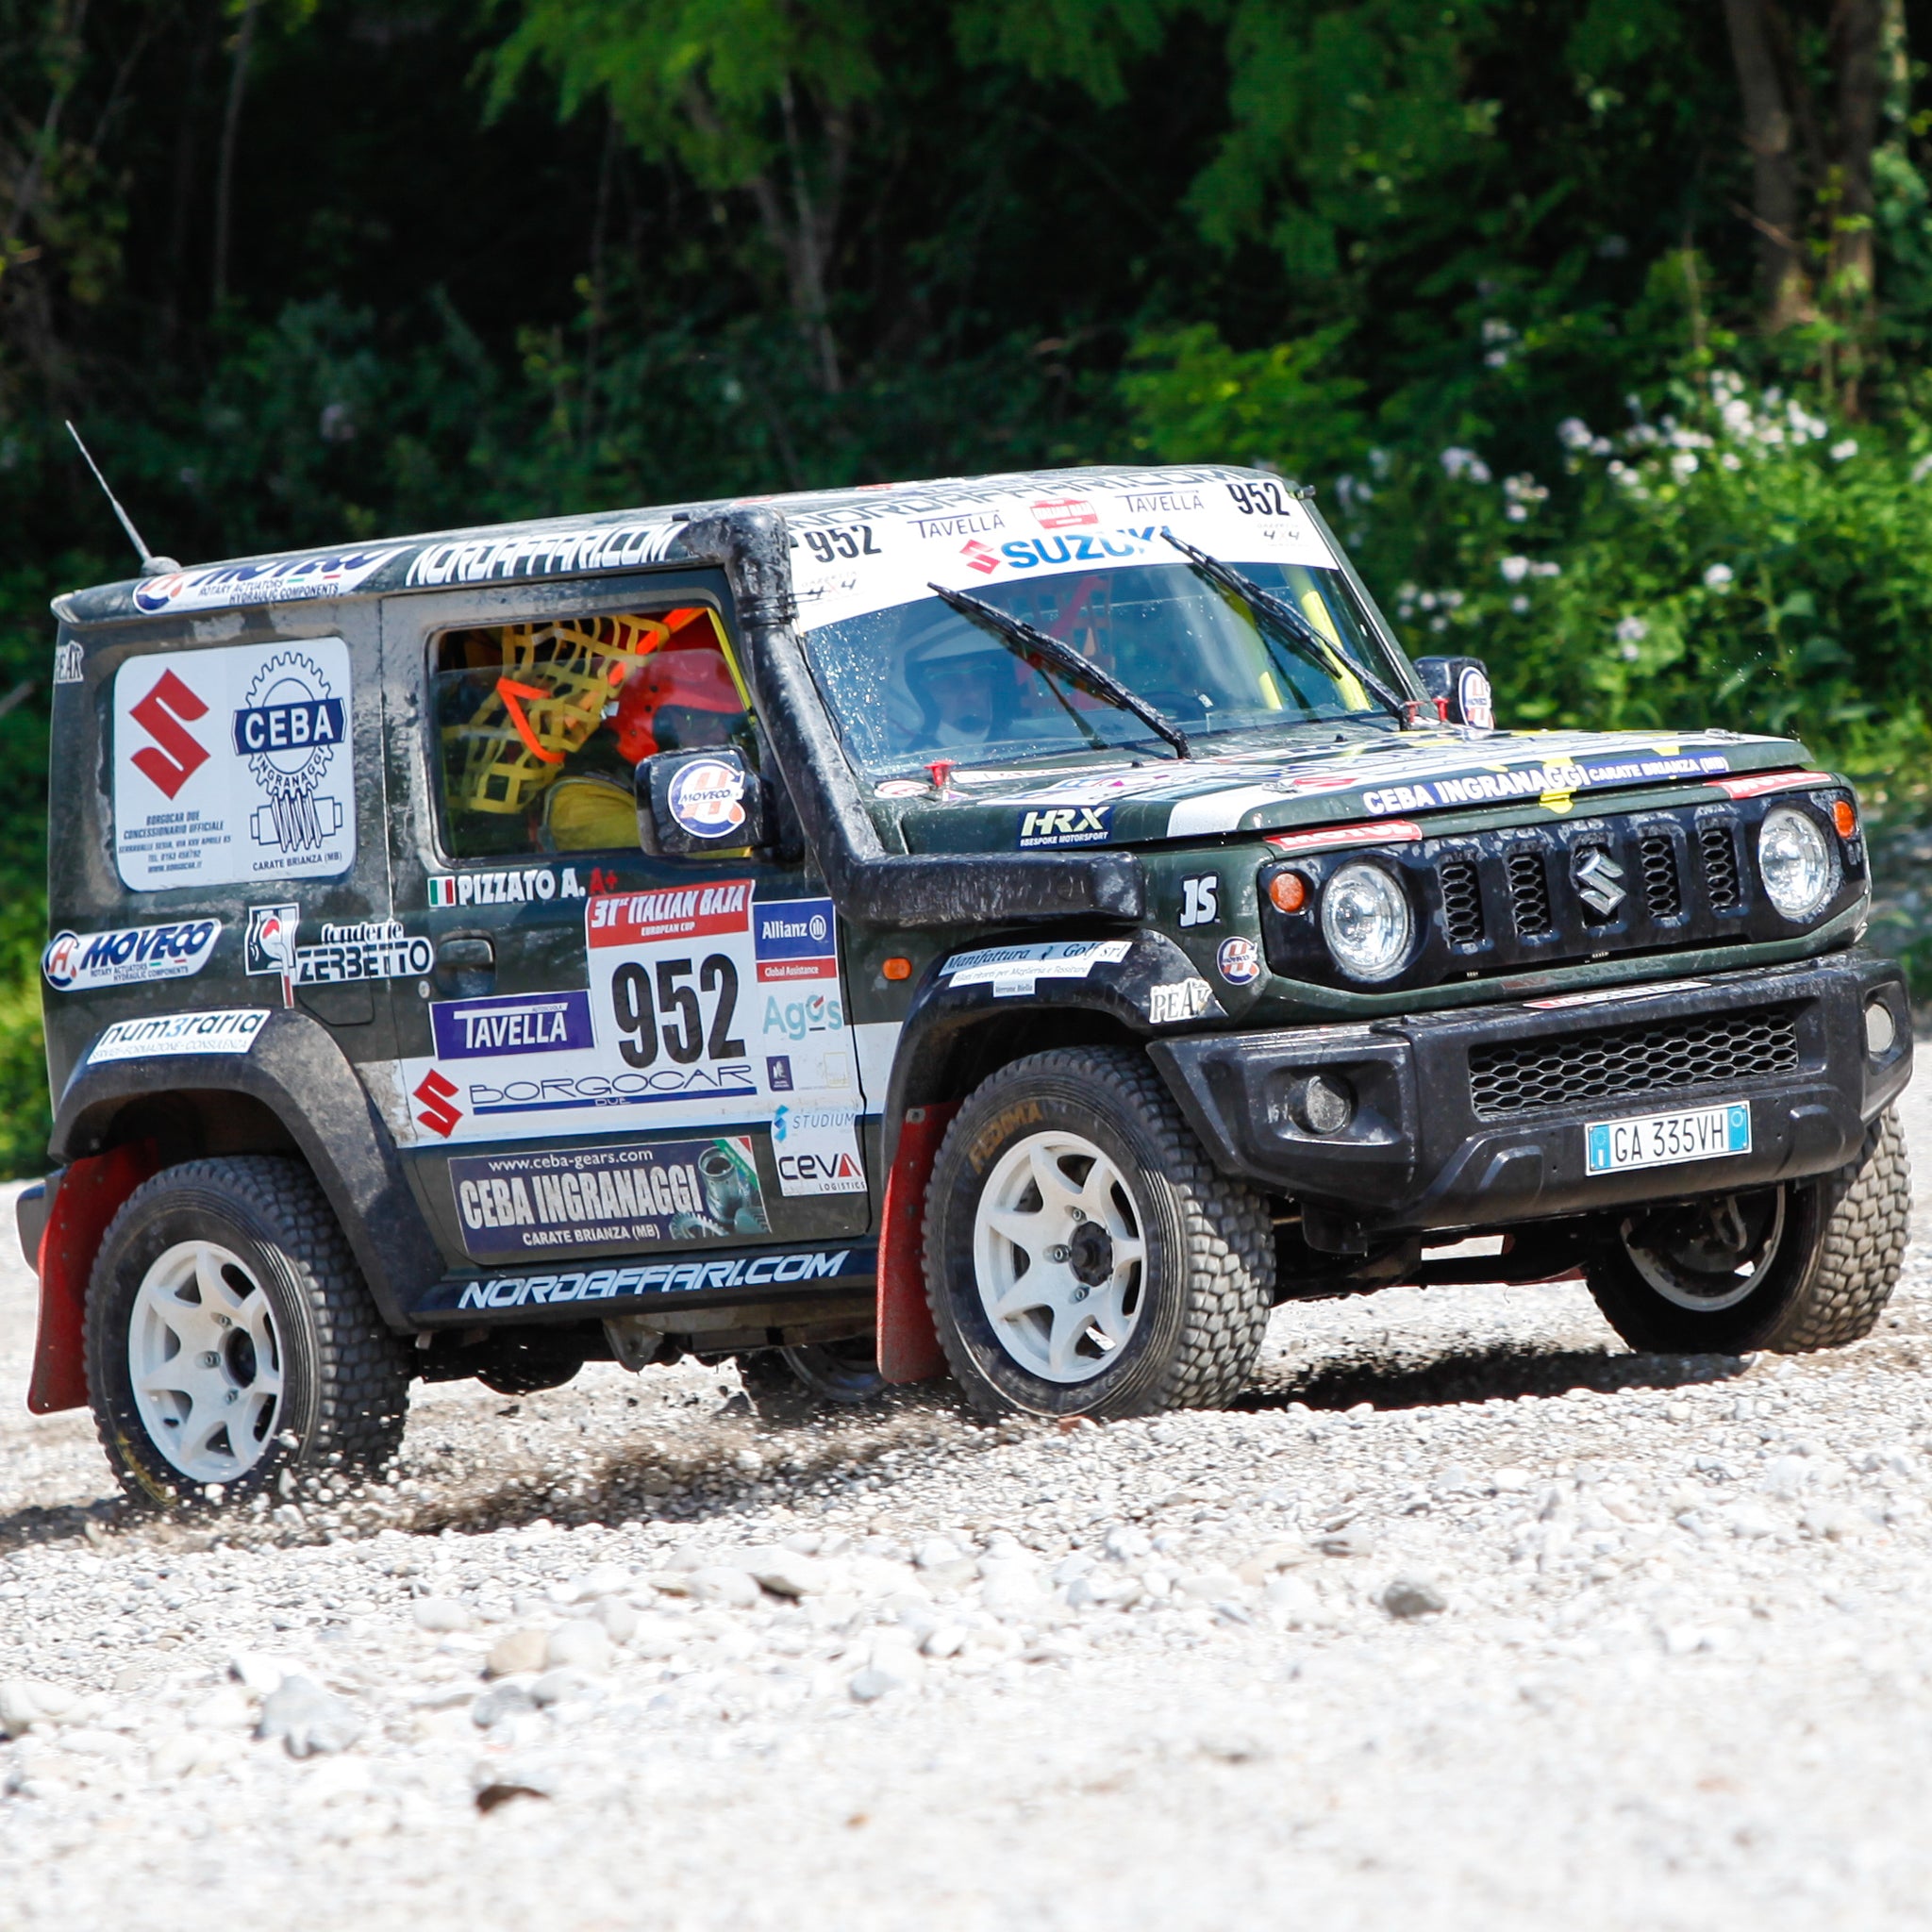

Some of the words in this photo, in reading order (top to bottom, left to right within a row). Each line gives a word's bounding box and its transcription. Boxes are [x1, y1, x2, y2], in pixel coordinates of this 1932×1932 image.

[1114, 491, 1204, 513] TAVELLA
[1226, 482, 1291, 516] 952
[907, 510, 1006, 539] TAVELLA
[406, 523, 687, 588] NORDAFFARI.COM
[804, 525, 883, 563] 952
[229, 590, 278, 605] HYDRAULIC
[280, 583, 339, 600] COMPONENTS
[245, 705, 334, 749] CEBA
[257, 747, 324, 788] INGRANAGGI
[1591, 764, 1641, 782] CARATE
[1641, 759, 1699, 776] BRIANZA
[681, 790, 731, 803] MOVECO
[1362, 784, 1435, 815] CEBA
[1439, 762, 1591, 805] INGRANAGGI
[1021, 807, 1110, 837] HRX
[1058, 831, 1108, 842] MOTORSPORT
[253, 859, 283, 871] CARATE
[287, 854, 323, 867] BRIANZA
[325, 851, 341, 864] (MB)
[458, 869, 556, 906] PIZZATO
[561, 867, 586, 898] A.
[589, 867, 618, 895] A+
[628, 891, 697, 924] ITALIAN
[699, 884, 743, 916] BAJA
[1180, 874, 1219, 926] JS
[324, 922, 403, 943] fonderie
[641, 924, 678, 937] EUROPEAN
[679, 921, 695, 932] CUP
[762, 920, 808, 940] Allianz
[79, 921, 214, 970] MOVECO
[943, 947, 1030, 970] Manifattura
[1063, 942, 1104, 960] Golf
[1100, 943, 1126, 958] srl
[91, 968, 111, 977] ROTARY
[113, 972, 147, 983] HYDRAULIC
[148, 966, 189, 978] COMPONENTS
[297, 941, 429, 982] ZERBETTO
[764, 967, 785, 977] Global
[786, 965, 819, 975] Assistance
[454, 1002, 568, 1049] TAVELLA
[610, 953, 745, 1069] 952
[100, 1013, 262, 1047] num3raria
[469, 1065, 753, 1105] BORGOCAR
[594, 1097, 631, 1107] DUE
[792, 1112, 855, 1129] STUDIUM
[1615, 1127, 1643, 1163] GA
[1653, 1113, 1724, 1158] 335VH
[488, 1148, 653, 1173] www.ceba-gears.com
[459, 1176, 535, 1229] CEBA
[533, 1164, 703, 1224] INGRANAGGI
[819, 1181, 865, 1191] LOGISTICS
[523, 1229, 572, 1246] CARATE
[575, 1225, 630, 1242] BRIANZA
[631, 1223, 659, 1241] (MB)
[458, 1250, 851, 1308] NORDAFFARI.COM
